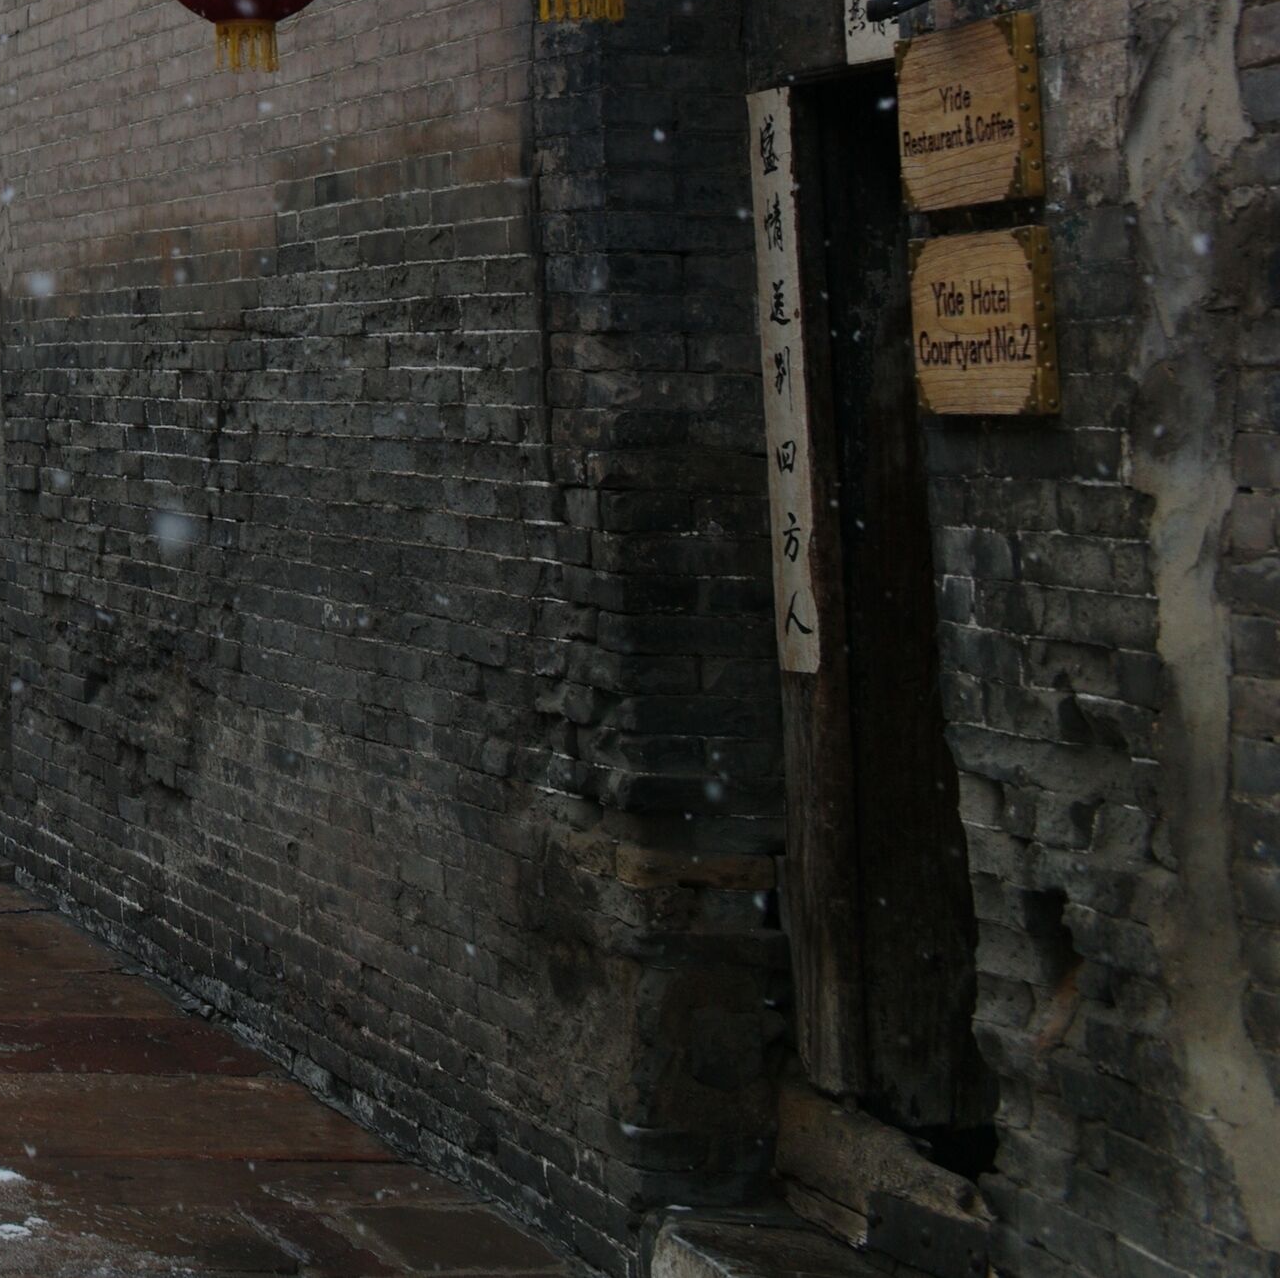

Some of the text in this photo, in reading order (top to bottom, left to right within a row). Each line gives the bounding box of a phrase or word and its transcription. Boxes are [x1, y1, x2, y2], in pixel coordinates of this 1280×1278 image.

[938, 83, 972, 114] Yide
[903, 112, 1015, 158] Restaurant & Coffee
[930, 277, 1011, 318] Yide Hotel
[919, 322, 1032, 371] Courtyard No.2
